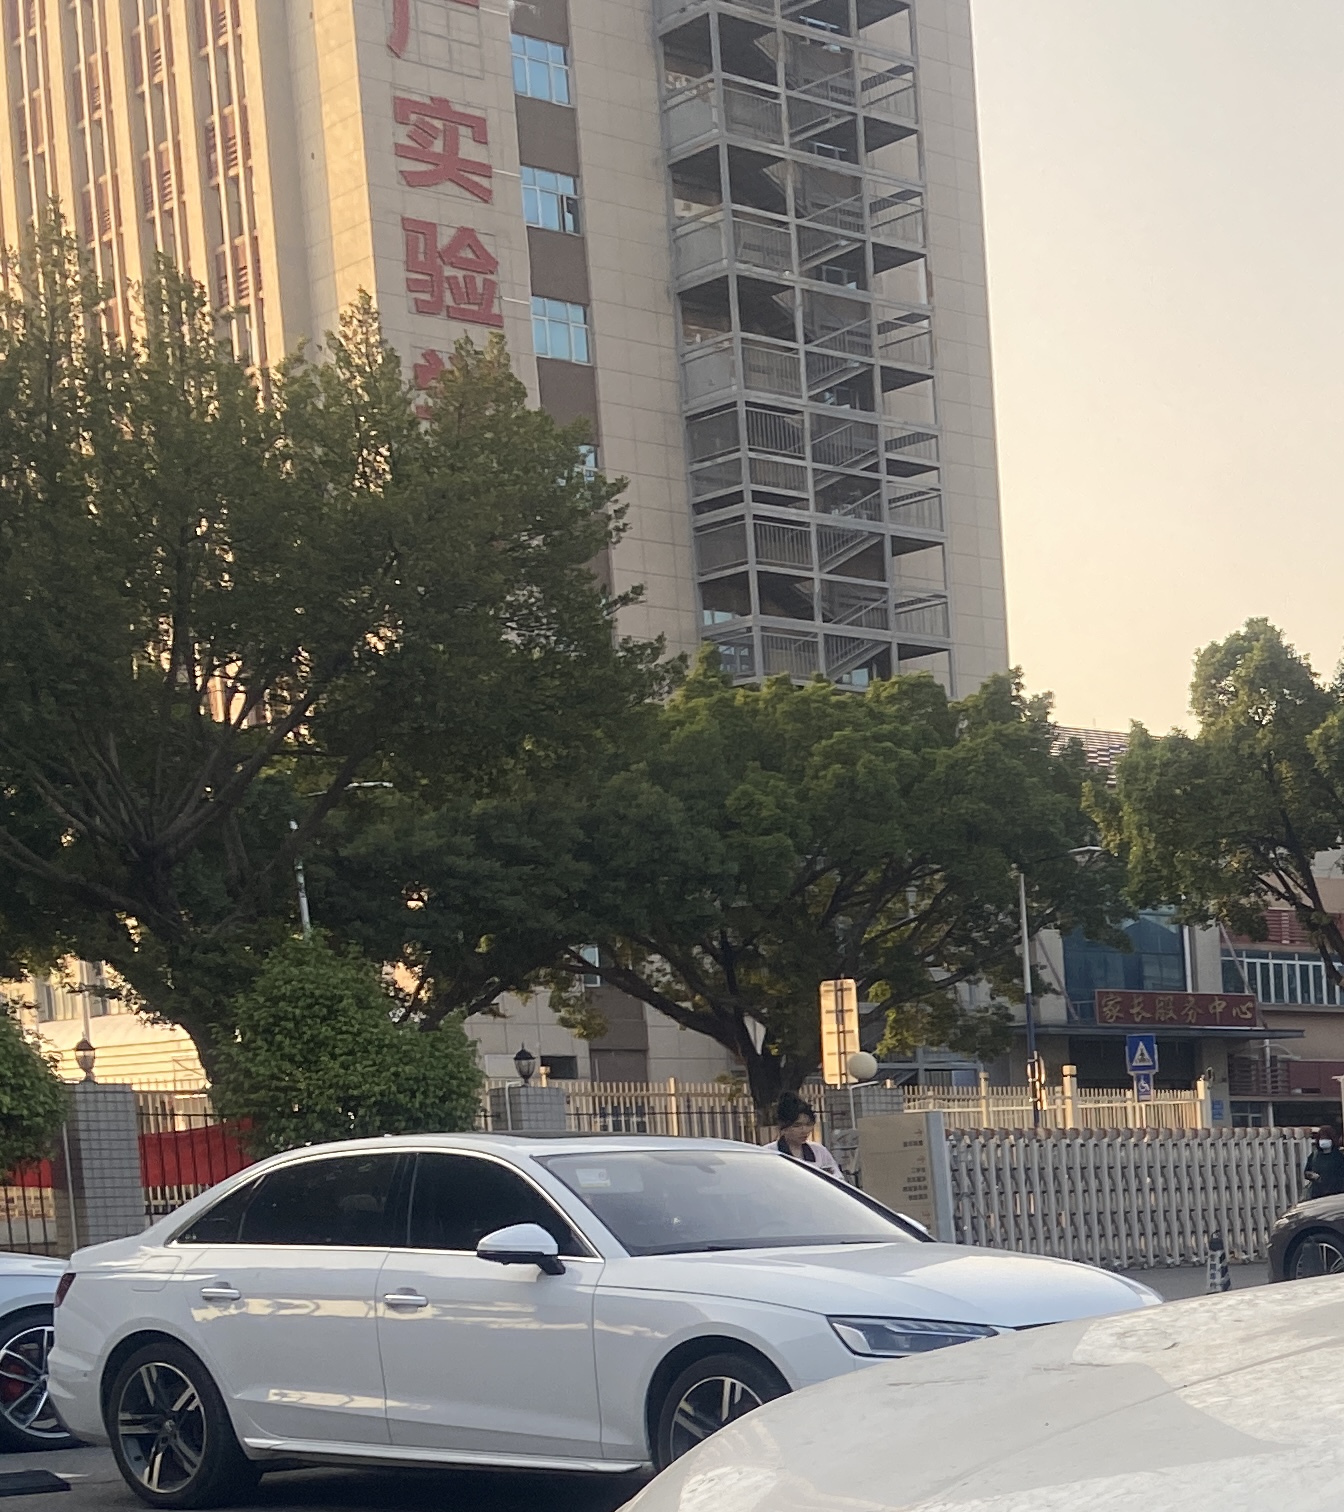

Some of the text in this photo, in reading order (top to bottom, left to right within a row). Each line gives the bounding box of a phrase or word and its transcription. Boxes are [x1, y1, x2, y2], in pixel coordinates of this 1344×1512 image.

[1100, 993, 1254, 1025] 家长服务中心
